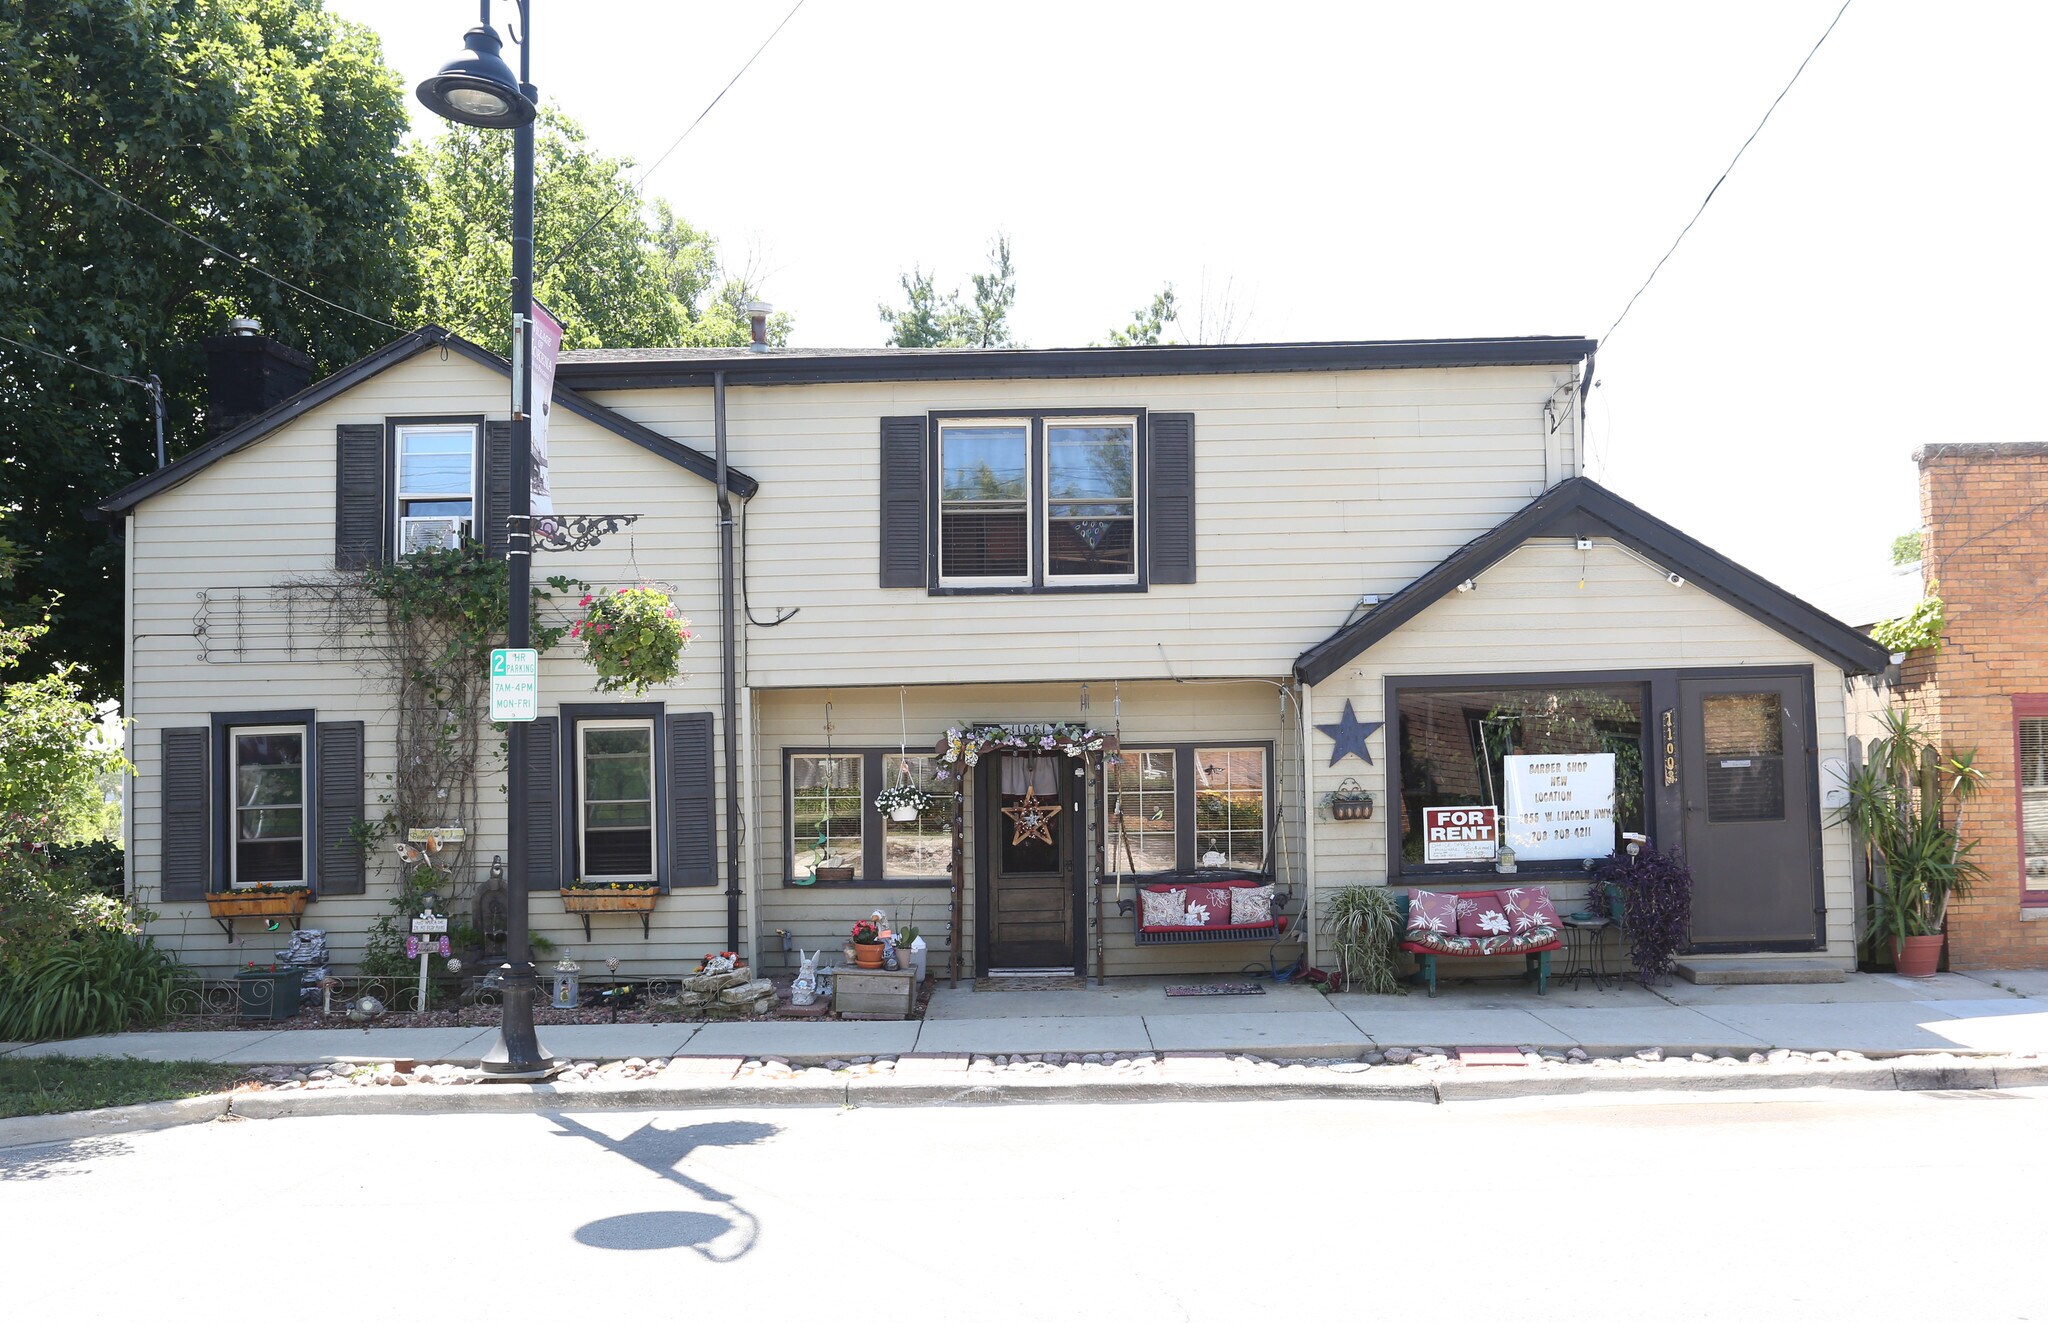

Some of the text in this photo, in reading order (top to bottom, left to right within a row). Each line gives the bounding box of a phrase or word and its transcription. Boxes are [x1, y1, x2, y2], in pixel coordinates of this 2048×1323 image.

[532, 341, 552, 373] OKENA
[494, 653, 526, 672] 2 HR
[507, 664, 534, 673] PARKING
[495, 683, 533, 692] 7AM-4PM
[496, 699, 531, 709] MON-FRI
[1529, 761, 1588, 774] BARBER SHOP
[1550, 776, 1568, 787] NEW
[1535, 791, 1572, 803] LOCATION
[1437, 811, 1484, 826] FOR
[1557, 809, 1589, 821] LINCOLN
[1430, 825, 1492, 841] RENT
